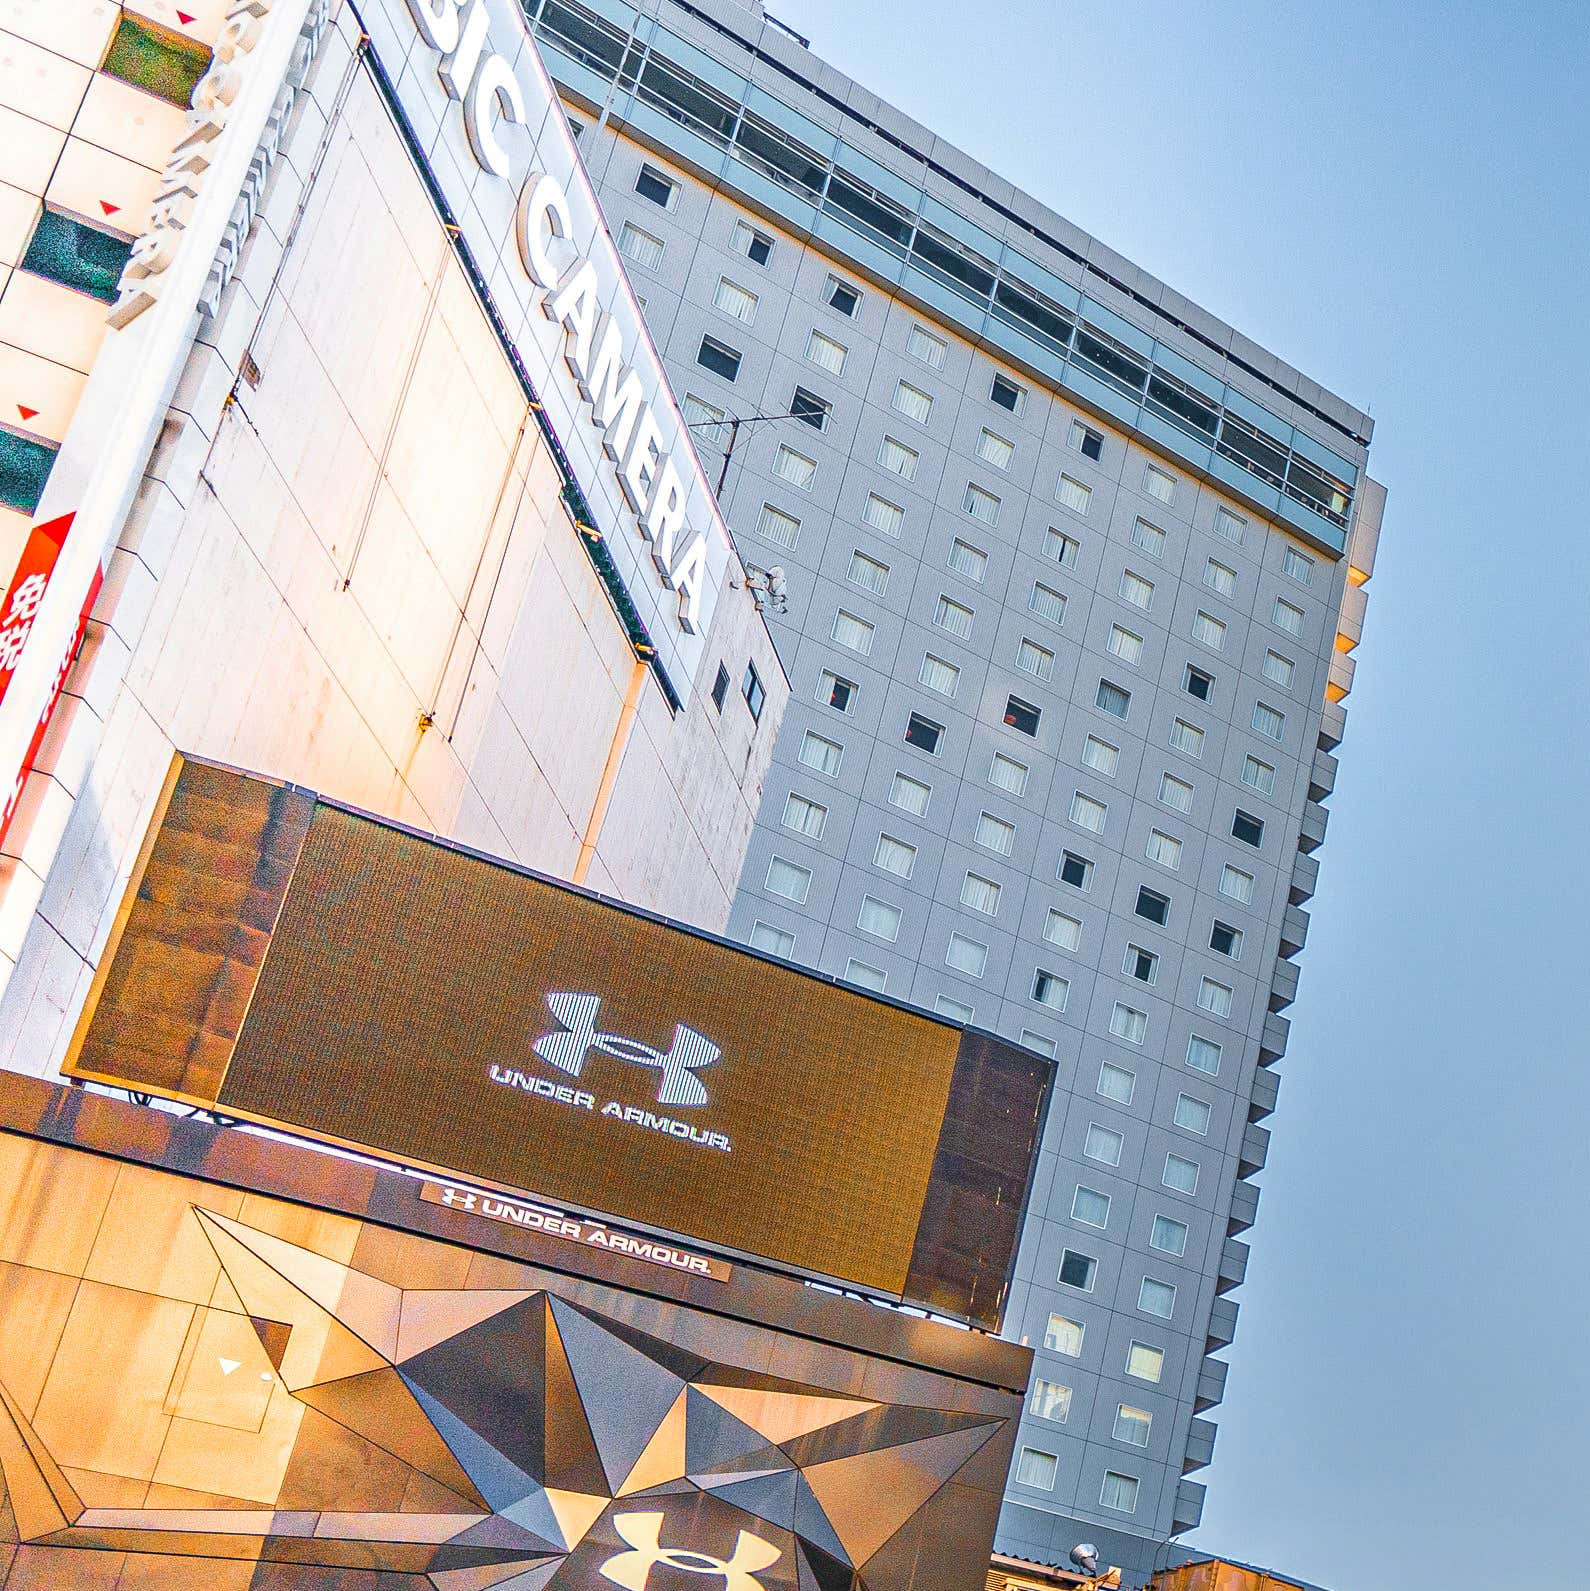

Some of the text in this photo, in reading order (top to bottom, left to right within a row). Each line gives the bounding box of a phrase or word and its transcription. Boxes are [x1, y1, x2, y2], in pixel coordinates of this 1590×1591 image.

[516, 172, 706, 636] CAMERA
[489, 1064, 596, 1111] UNDER
[482, 1200, 581, 1238] UNDER
